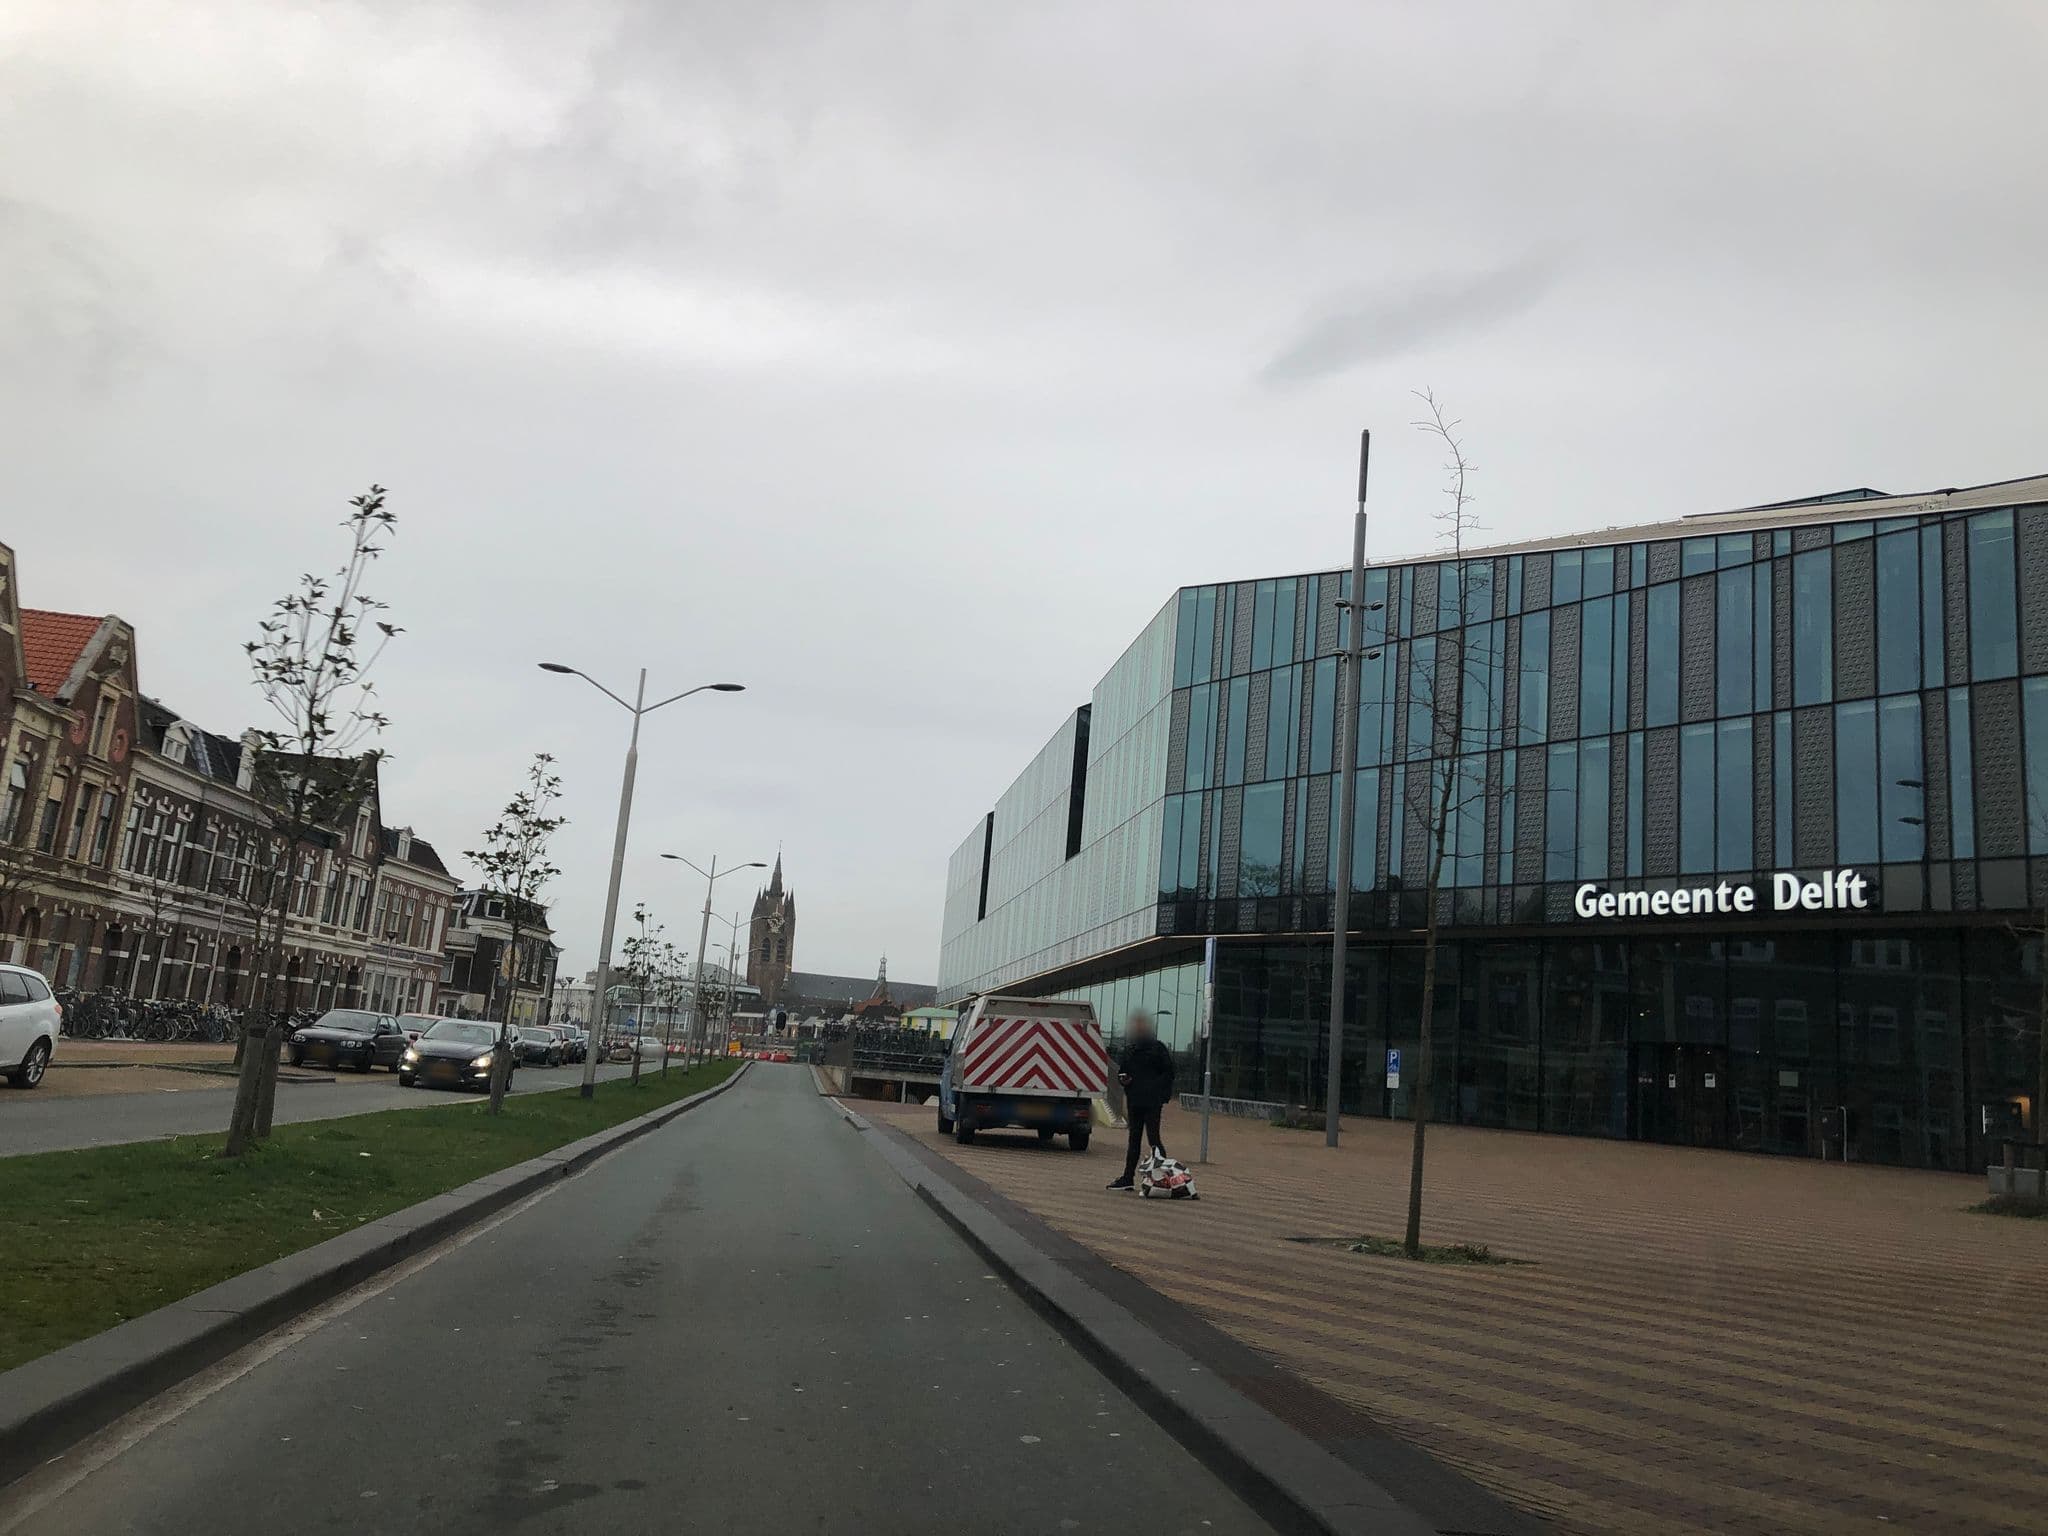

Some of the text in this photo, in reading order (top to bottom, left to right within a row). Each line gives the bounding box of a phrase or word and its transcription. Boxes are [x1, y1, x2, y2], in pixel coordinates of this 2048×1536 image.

[1575, 869, 1868, 918] Gemeente Delft
[1390, 1051, 1398, 1064] P
